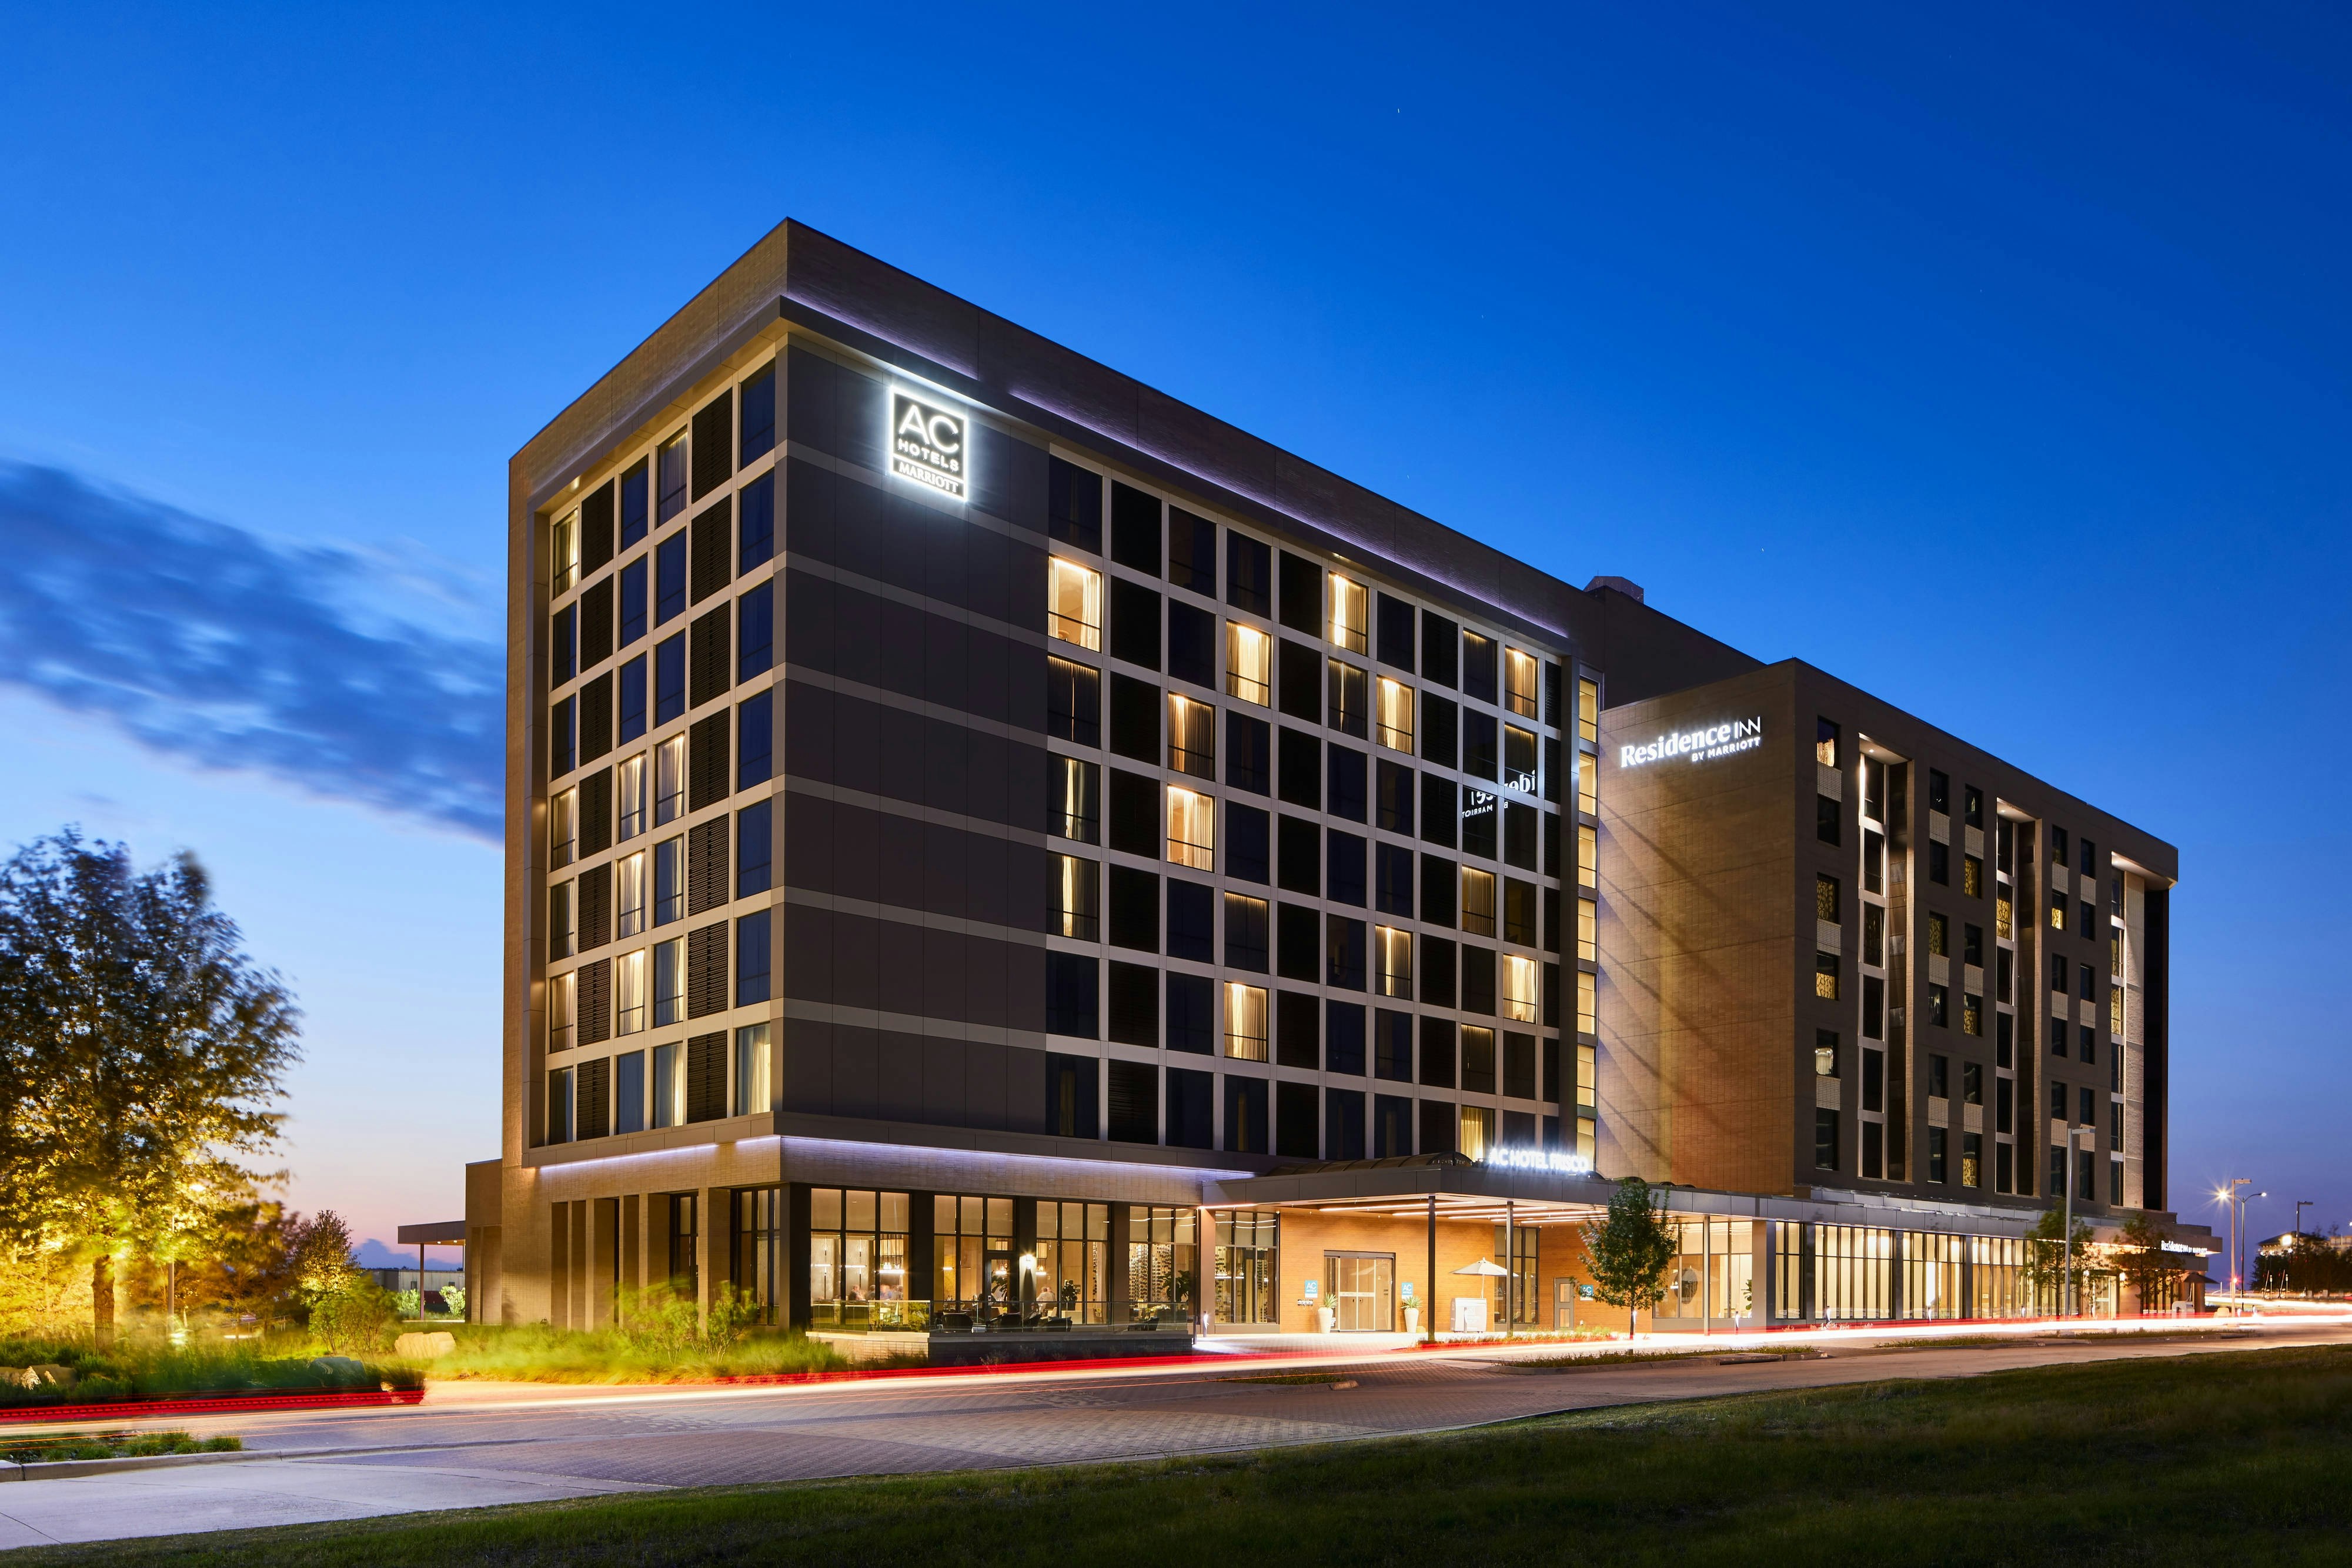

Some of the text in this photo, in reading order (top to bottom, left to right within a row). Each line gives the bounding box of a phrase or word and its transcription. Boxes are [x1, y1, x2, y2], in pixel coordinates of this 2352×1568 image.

[898, 404, 958, 453] AC
[898, 438, 959, 472] HOTELS
[898, 462, 958, 493] MARRIOTT
[1621, 716, 1760, 767] Residence INN
[1692, 737, 1760, 762] BY MARRIOTT
[1489, 1148, 1508, 1166] AC
[1510, 1150, 1548, 1169] HOTEL
